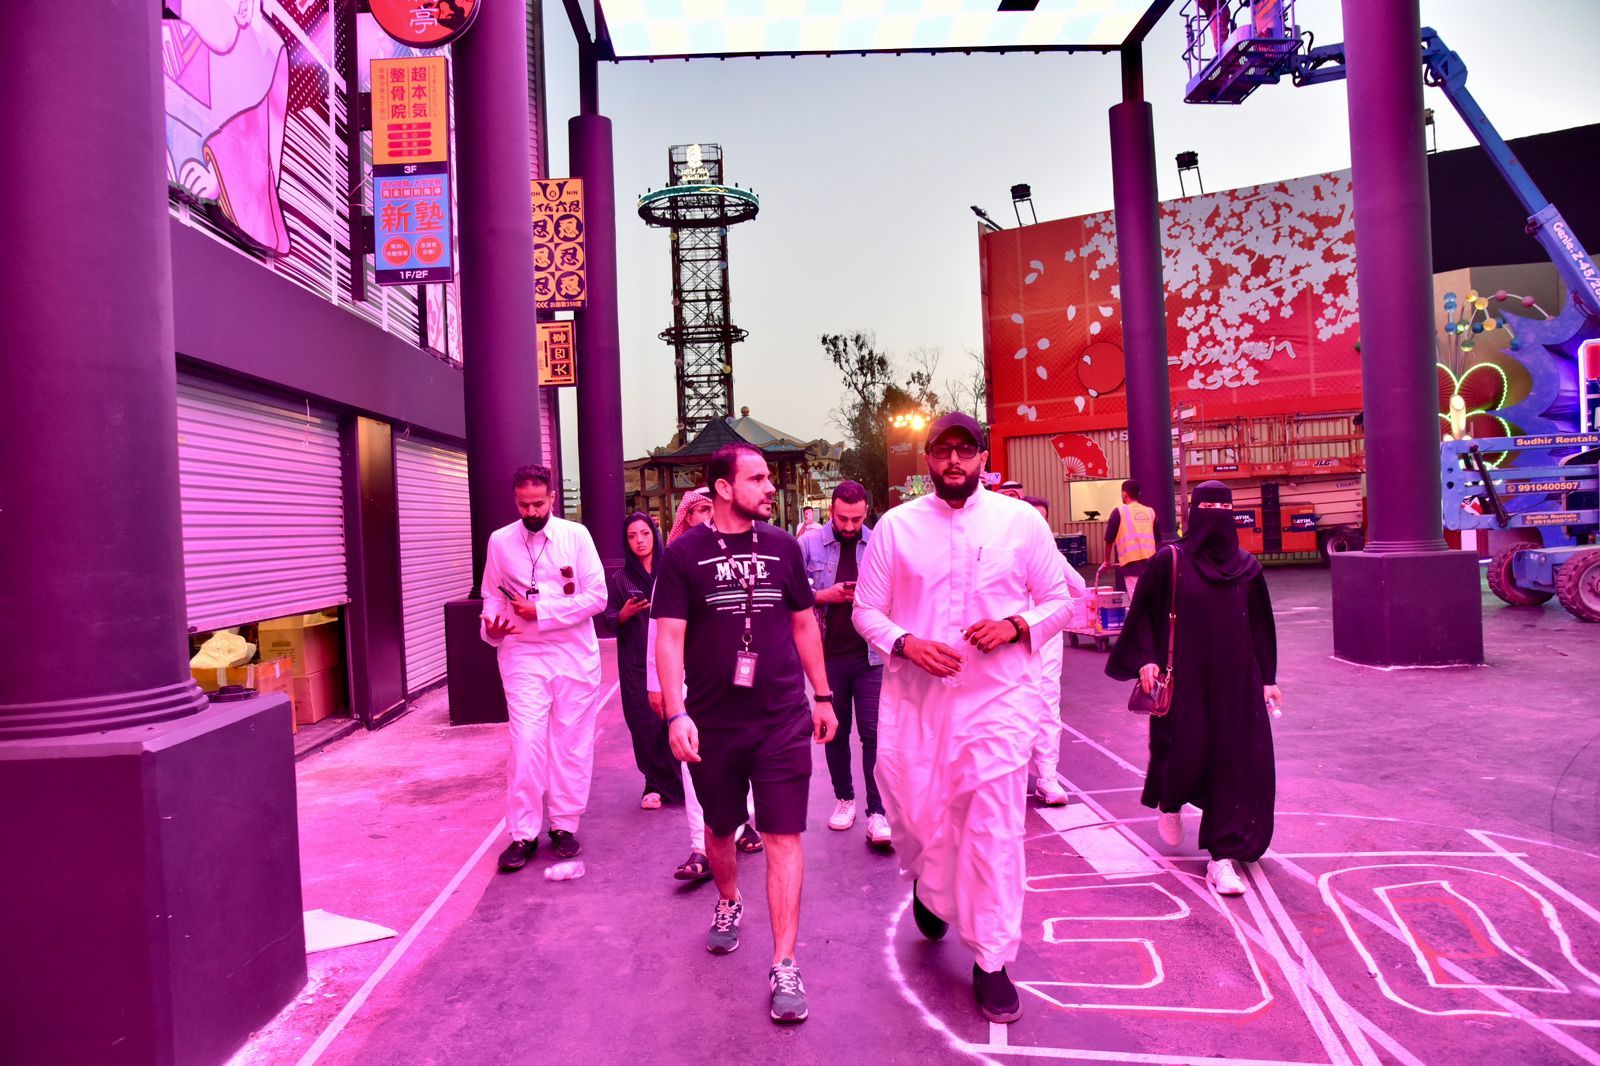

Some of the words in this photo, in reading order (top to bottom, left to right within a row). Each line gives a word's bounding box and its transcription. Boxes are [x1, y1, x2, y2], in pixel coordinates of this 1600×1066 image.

[390, 68, 406, 119] 整骨院
[411, 67, 428, 118] 超本気
[404, 165, 417, 174] 3F
[381, 201, 445, 233] 新塾
[400, 270, 428, 279] 1F/2F
[1516, 437, 1553, 446] Sudhir
[1555, 434, 1598, 444] Rentals
[1518, 482, 1578, 492] 9910400507
